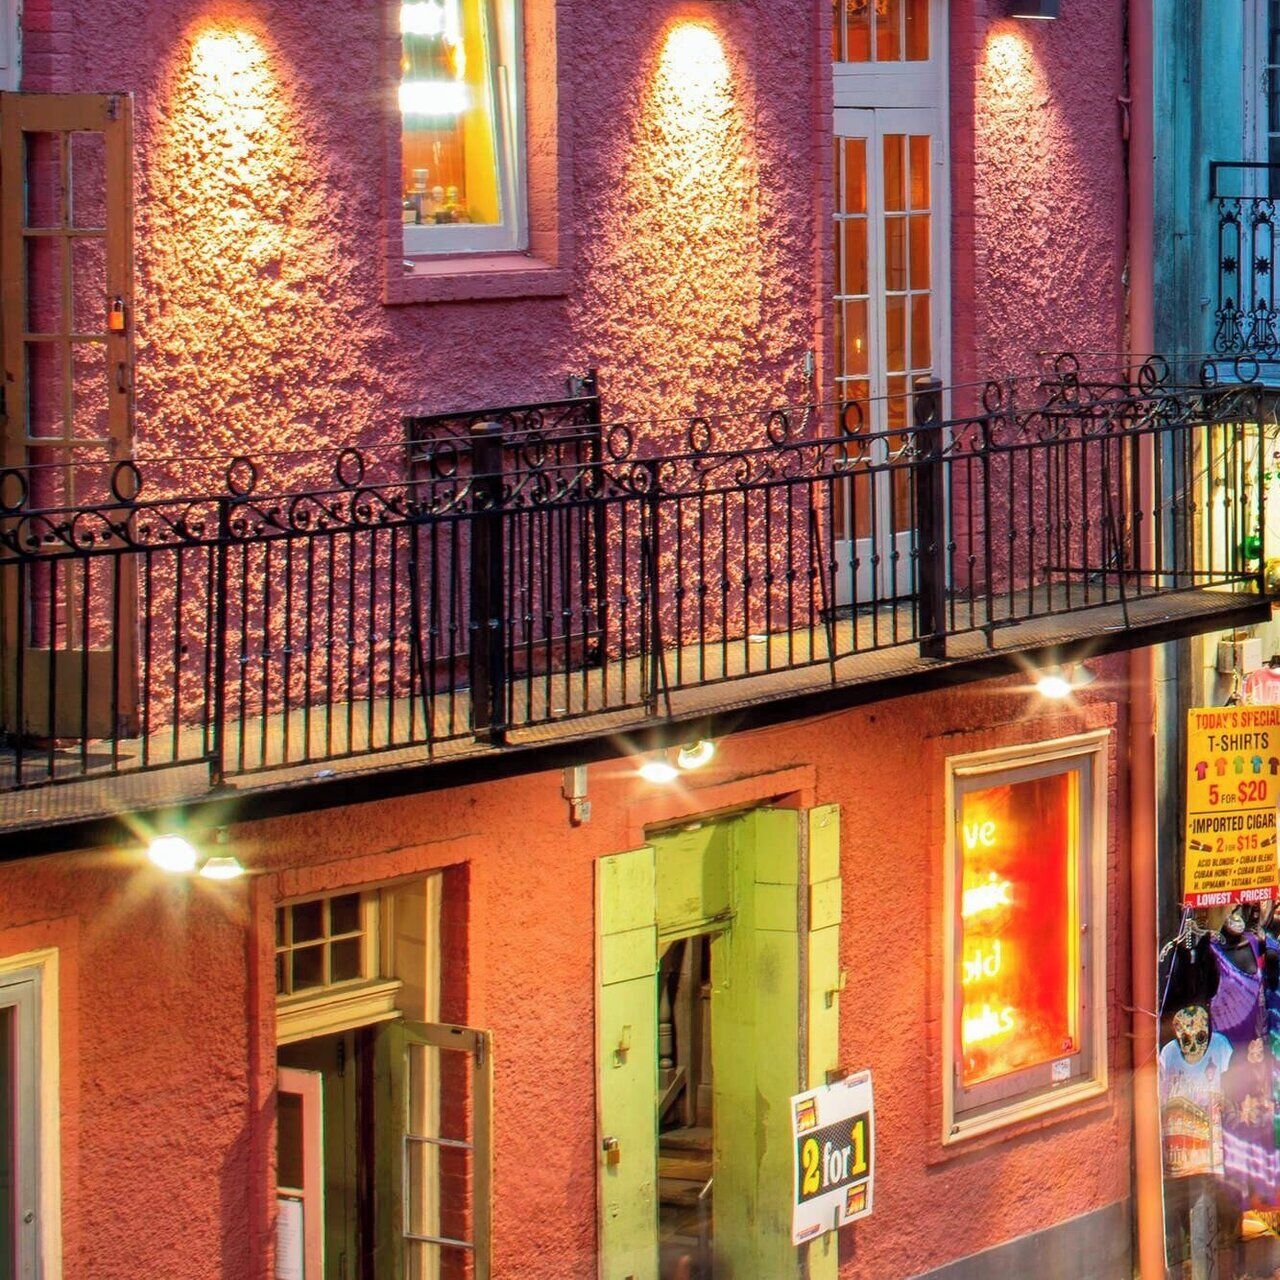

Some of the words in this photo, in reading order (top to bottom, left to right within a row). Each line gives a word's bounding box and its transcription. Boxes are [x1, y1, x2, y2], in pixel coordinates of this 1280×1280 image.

[1196, 712, 1237, 730] TODAY'S
[1241, 709, 1280, 727] SPECIAL
[1208, 733, 1269, 751] T-SHIRTS
[1209, 784, 1219, 805] 5
[1221, 793, 1236, 804] FOR
[1238, 779, 1267, 805] $20
[1192, 815, 1243, 834] IMPORTED
[1217, 837, 1224, 853] 2
[1237, 834, 1258, 851] $15
[1197, 892, 1233, 906] LOWEST
[1240, 888, 1272, 902] PRICES!
[802, 1138, 820, 1196] 2
[822, 1141, 852, 1187] for
[851, 1120, 867, 1176] 1
